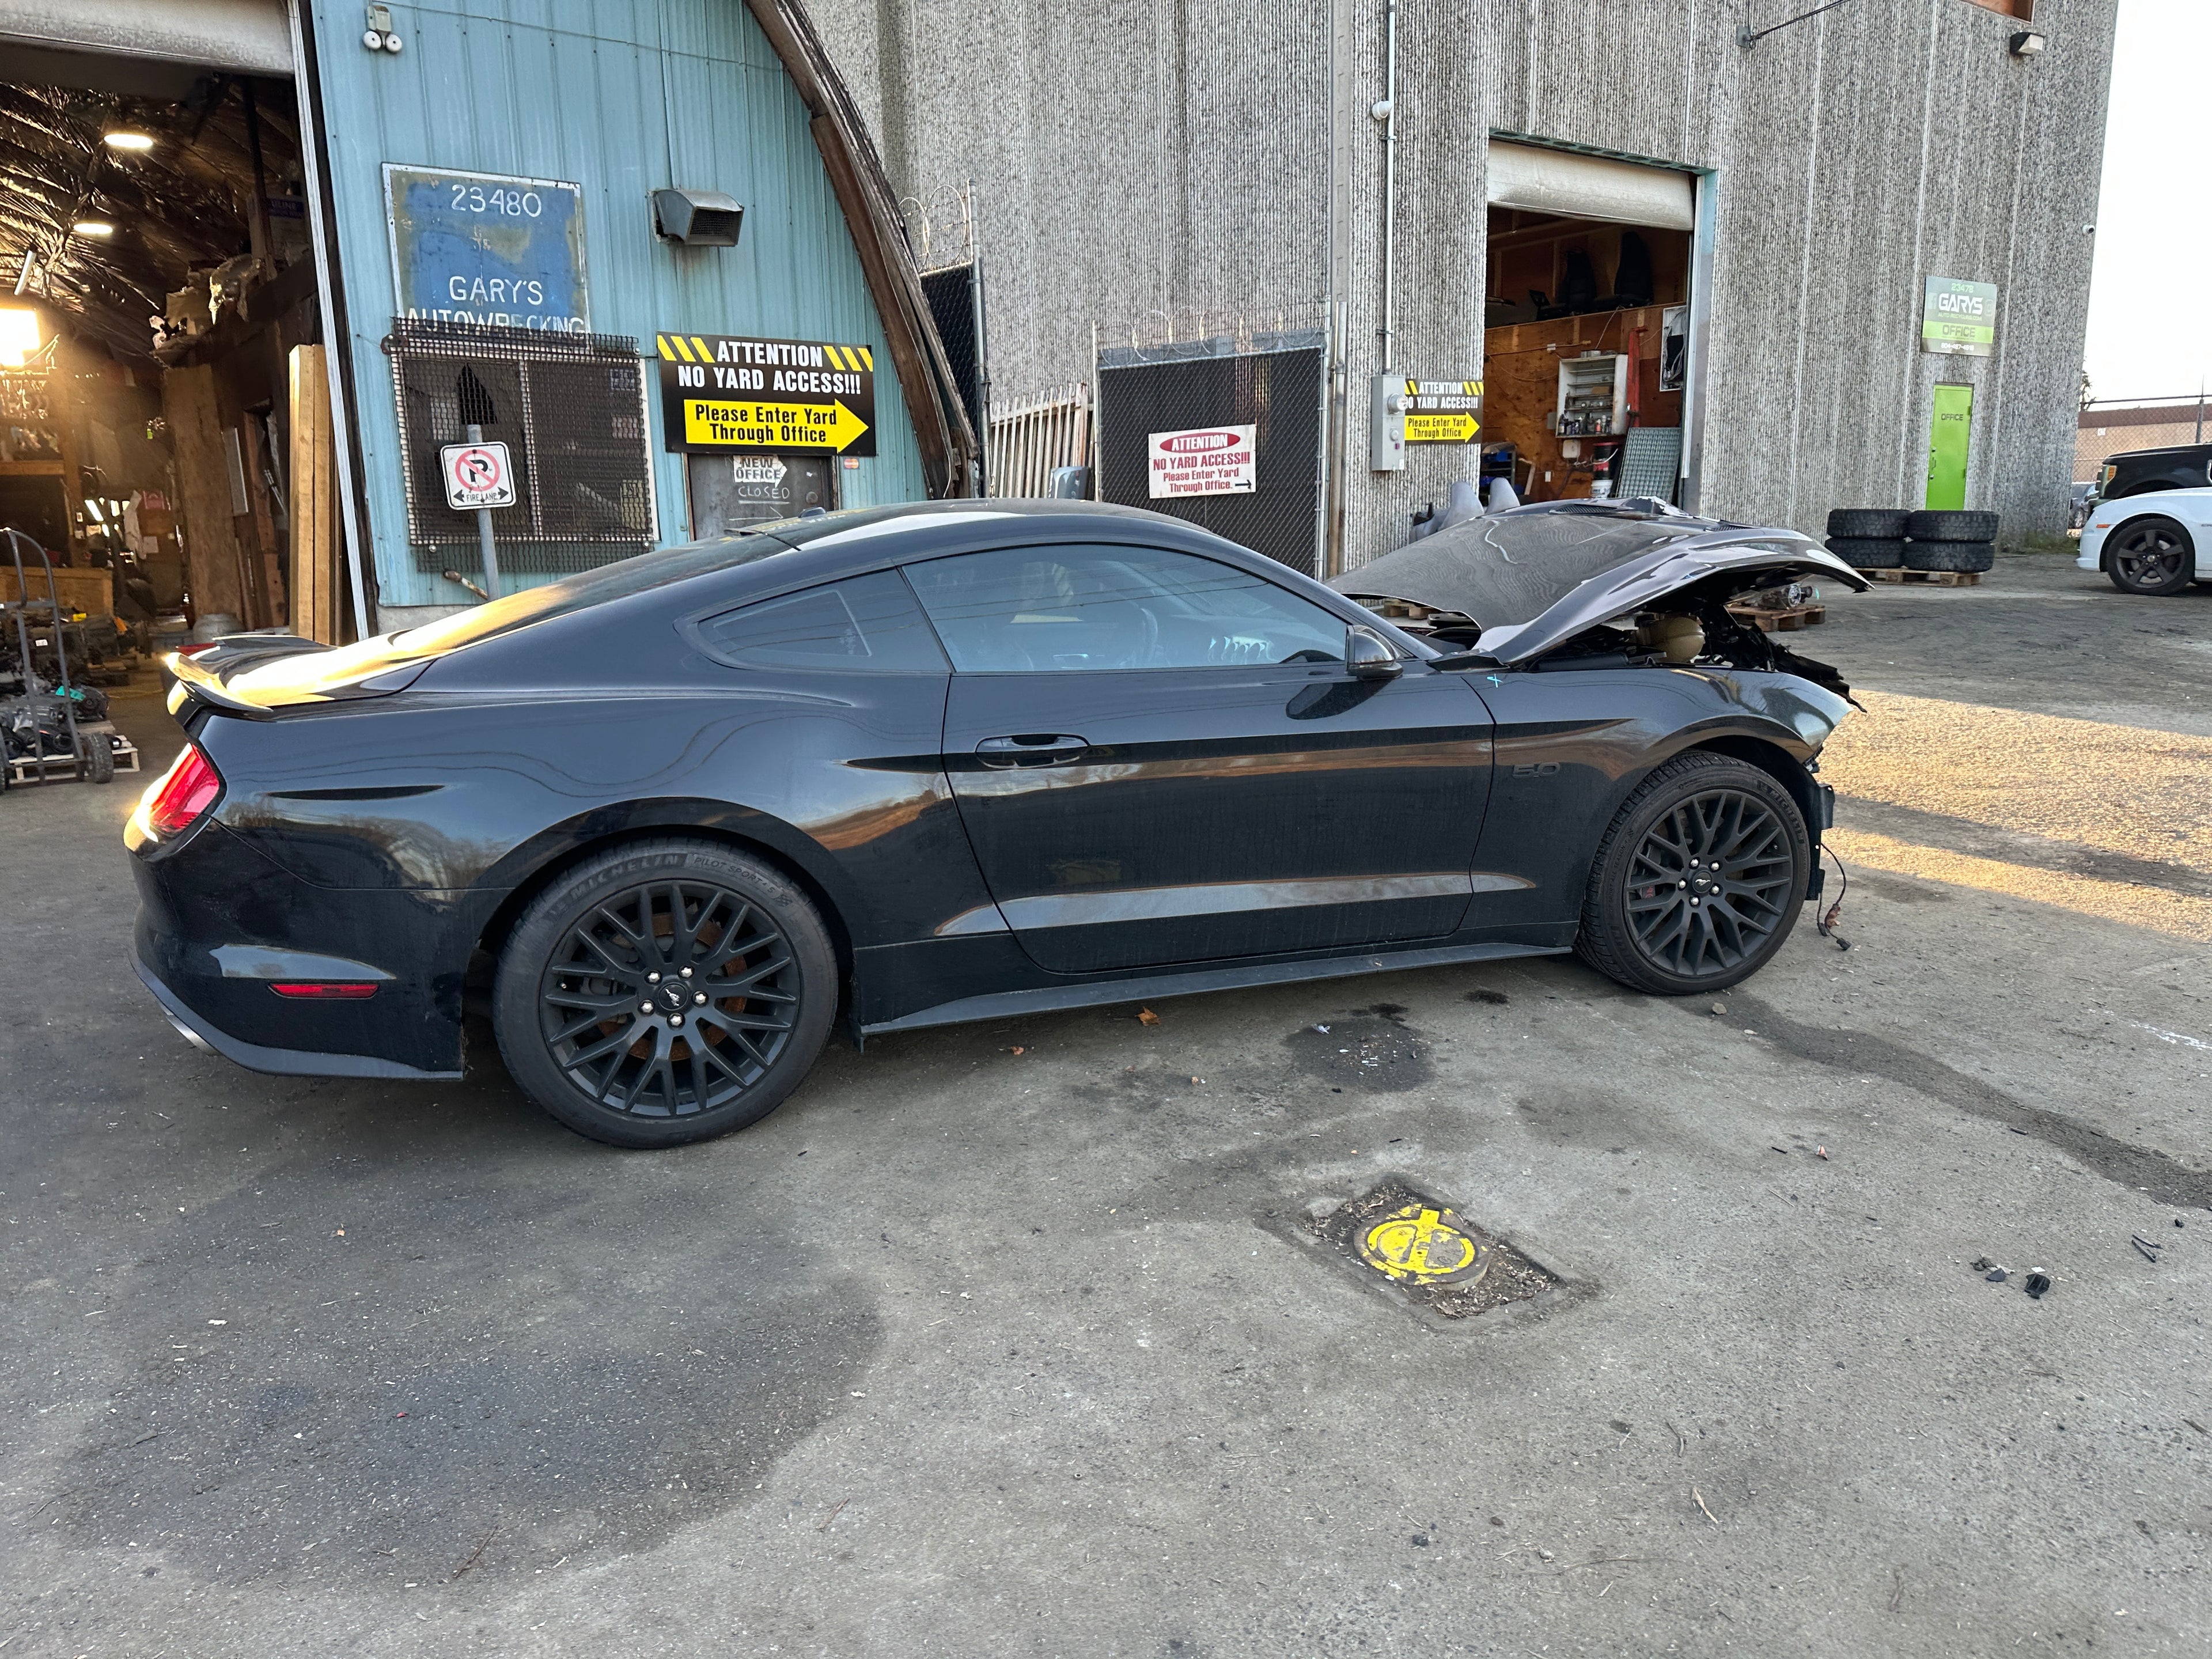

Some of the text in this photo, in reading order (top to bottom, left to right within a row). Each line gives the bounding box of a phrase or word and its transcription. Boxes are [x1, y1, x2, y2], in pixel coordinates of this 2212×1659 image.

[451, 184, 542, 218] 23480
[449, 275, 543, 305] GARY'S
[1938, 293, 1984, 315] GARYS
[1942, 324, 1976, 338] OFFICE
[717, 340, 823, 368] ATTENTION
[677, 365, 861, 395] NO YARD ACCESS!!!
[1419, 381, 1463, 395] ATTENTION
[1417, 396, 1438, 409] YARD
[1441, 396, 1478, 409] ACCESS!!!
[695, 404, 837, 426] Please Enter Yard
[1408, 417, 1467, 427] Please Enter Yard
[1941, 413, 1963, 421] OFFICE
[709, 423, 827, 444] Through Office
[1414, 428, 1461, 439] Through Office
[1171, 434, 1228, 452] ATTENTION
[741, 457, 773, 468] NEW
[1153, 452, 1250, 471] NO YARD ACCESS!!!
[736, 468, 782, 480] OFFICE
[1163, 467, 1239, 482] Please Enter Yard
[738, 486, 790, 499] CLOSED
[1169, 480, 1203, 493] Through
[466, 494, 479, 502] FIRE
[1512, 762, 1560, 778] 5.0
[570, 855, 679, 899] MICHELIN
[694, 857, 727, 868] PILOT
[728, 865, 763, 884] SPORT
